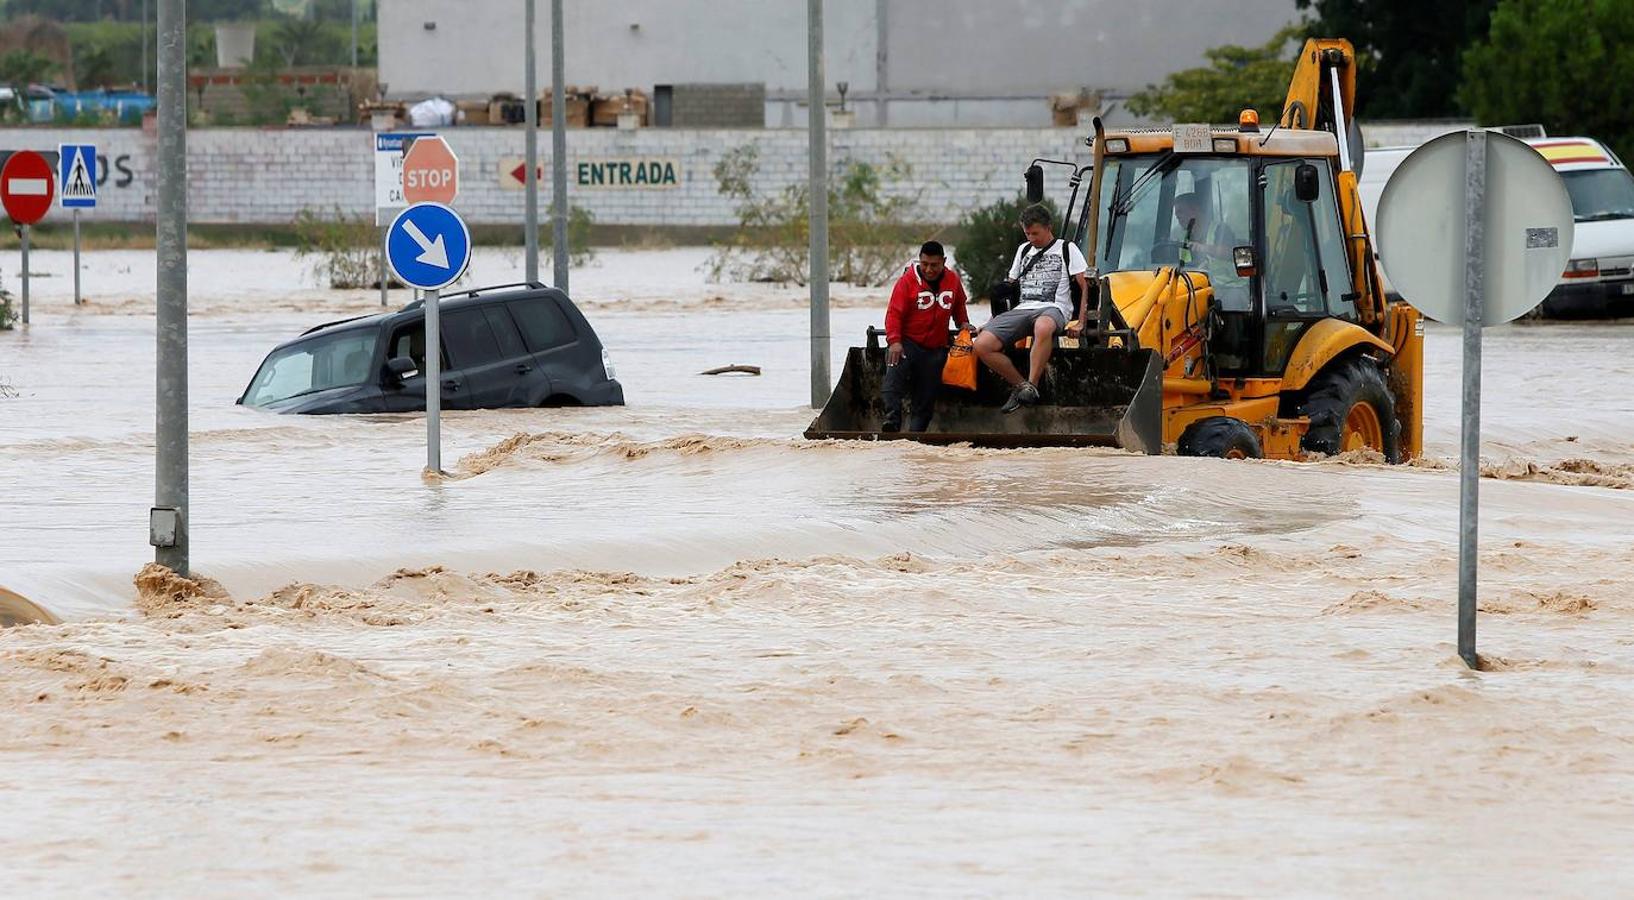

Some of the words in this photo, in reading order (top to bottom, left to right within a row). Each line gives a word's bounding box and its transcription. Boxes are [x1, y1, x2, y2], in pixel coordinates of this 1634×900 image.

[408, 168, 453, 188] STOP
[577, 161, 676, 185] ENTRADA
[916, 290, 954, 310] DC
